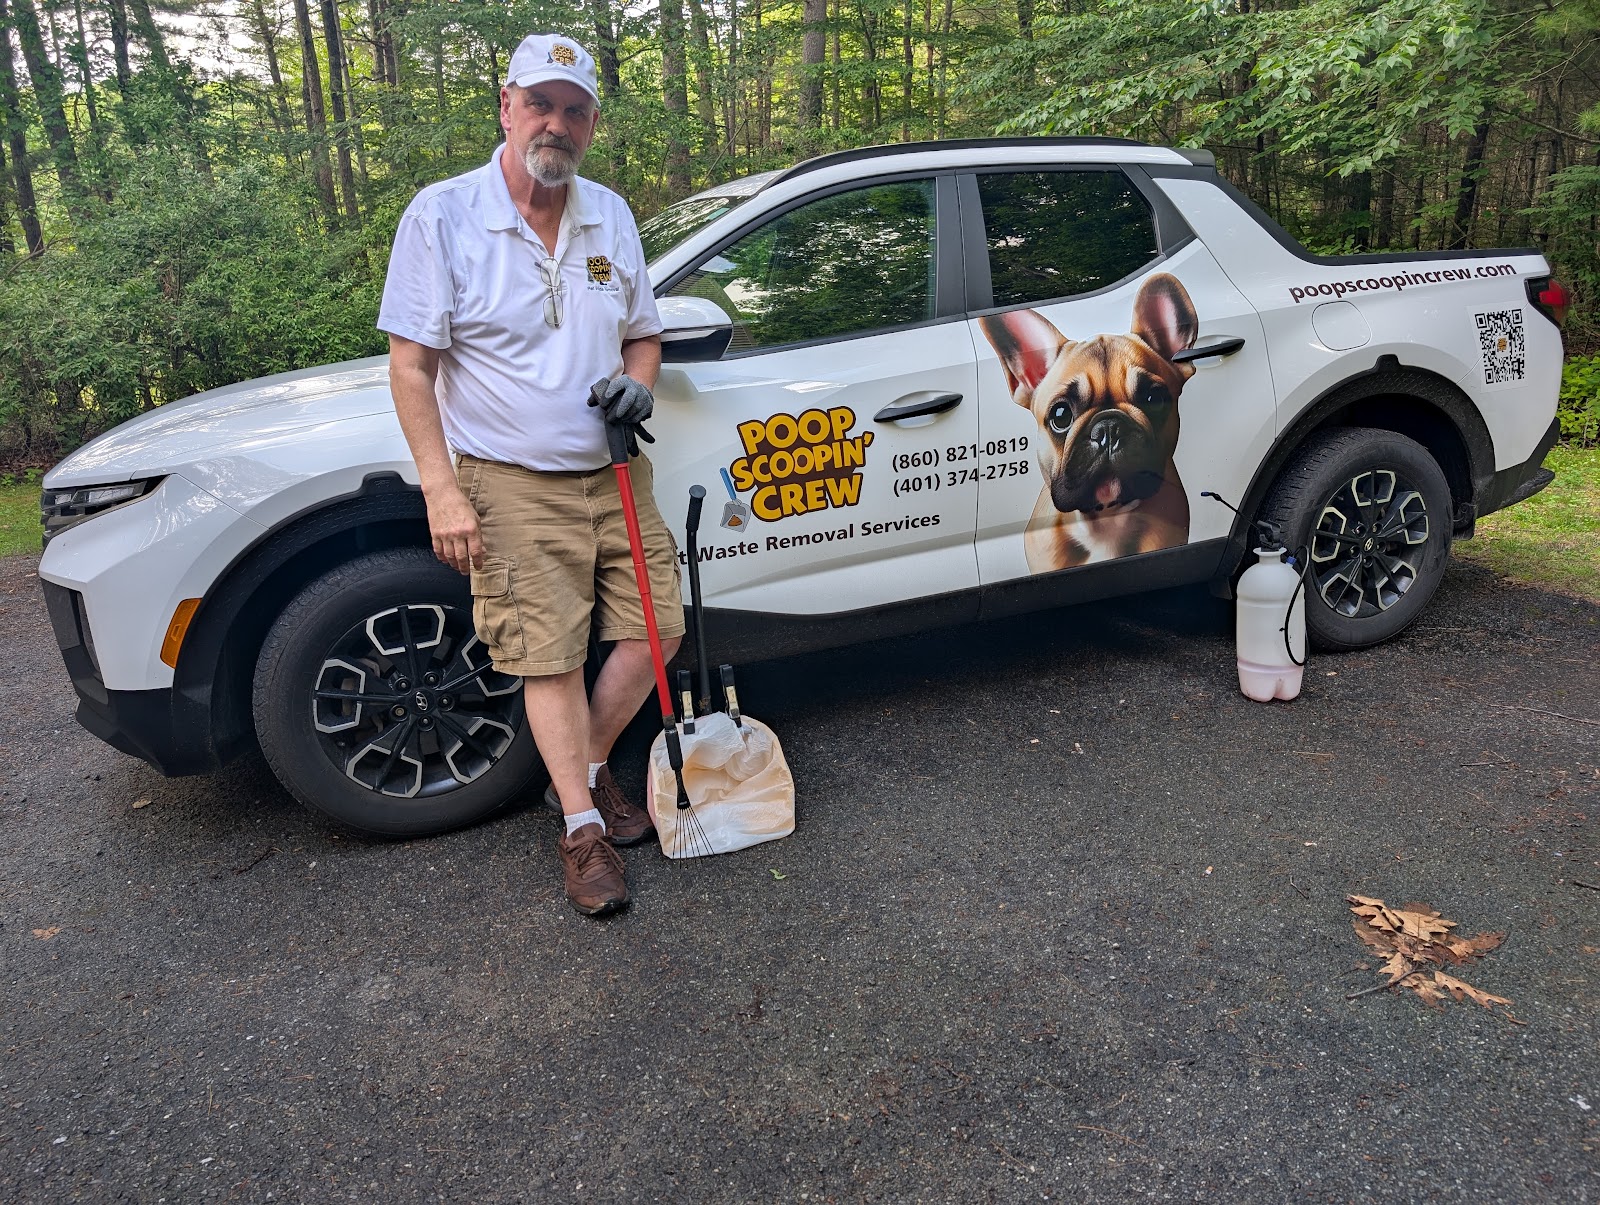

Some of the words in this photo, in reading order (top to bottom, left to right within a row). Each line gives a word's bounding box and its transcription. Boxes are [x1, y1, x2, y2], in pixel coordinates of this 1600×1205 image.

[587, 256, 608, 265] OOP
[1288, 264, 1517, 303] poopscoopincrew.com
[737, 406, 856, 456] POOP
[730, 431, 874, 492] SCOOPIN'
[892, 449, 939, 473] (860)
[946, 436, 1029, 462] 821-0819
[751, 473, 863, 522] CREW
[893, 473, 941, 497] (401)
[947, 460, 1029, 486] 374-2758
[696, 541, 759, 562] Waste
[766, 523, 854, 551] Removal
[861, 514, 940, 537] Services
